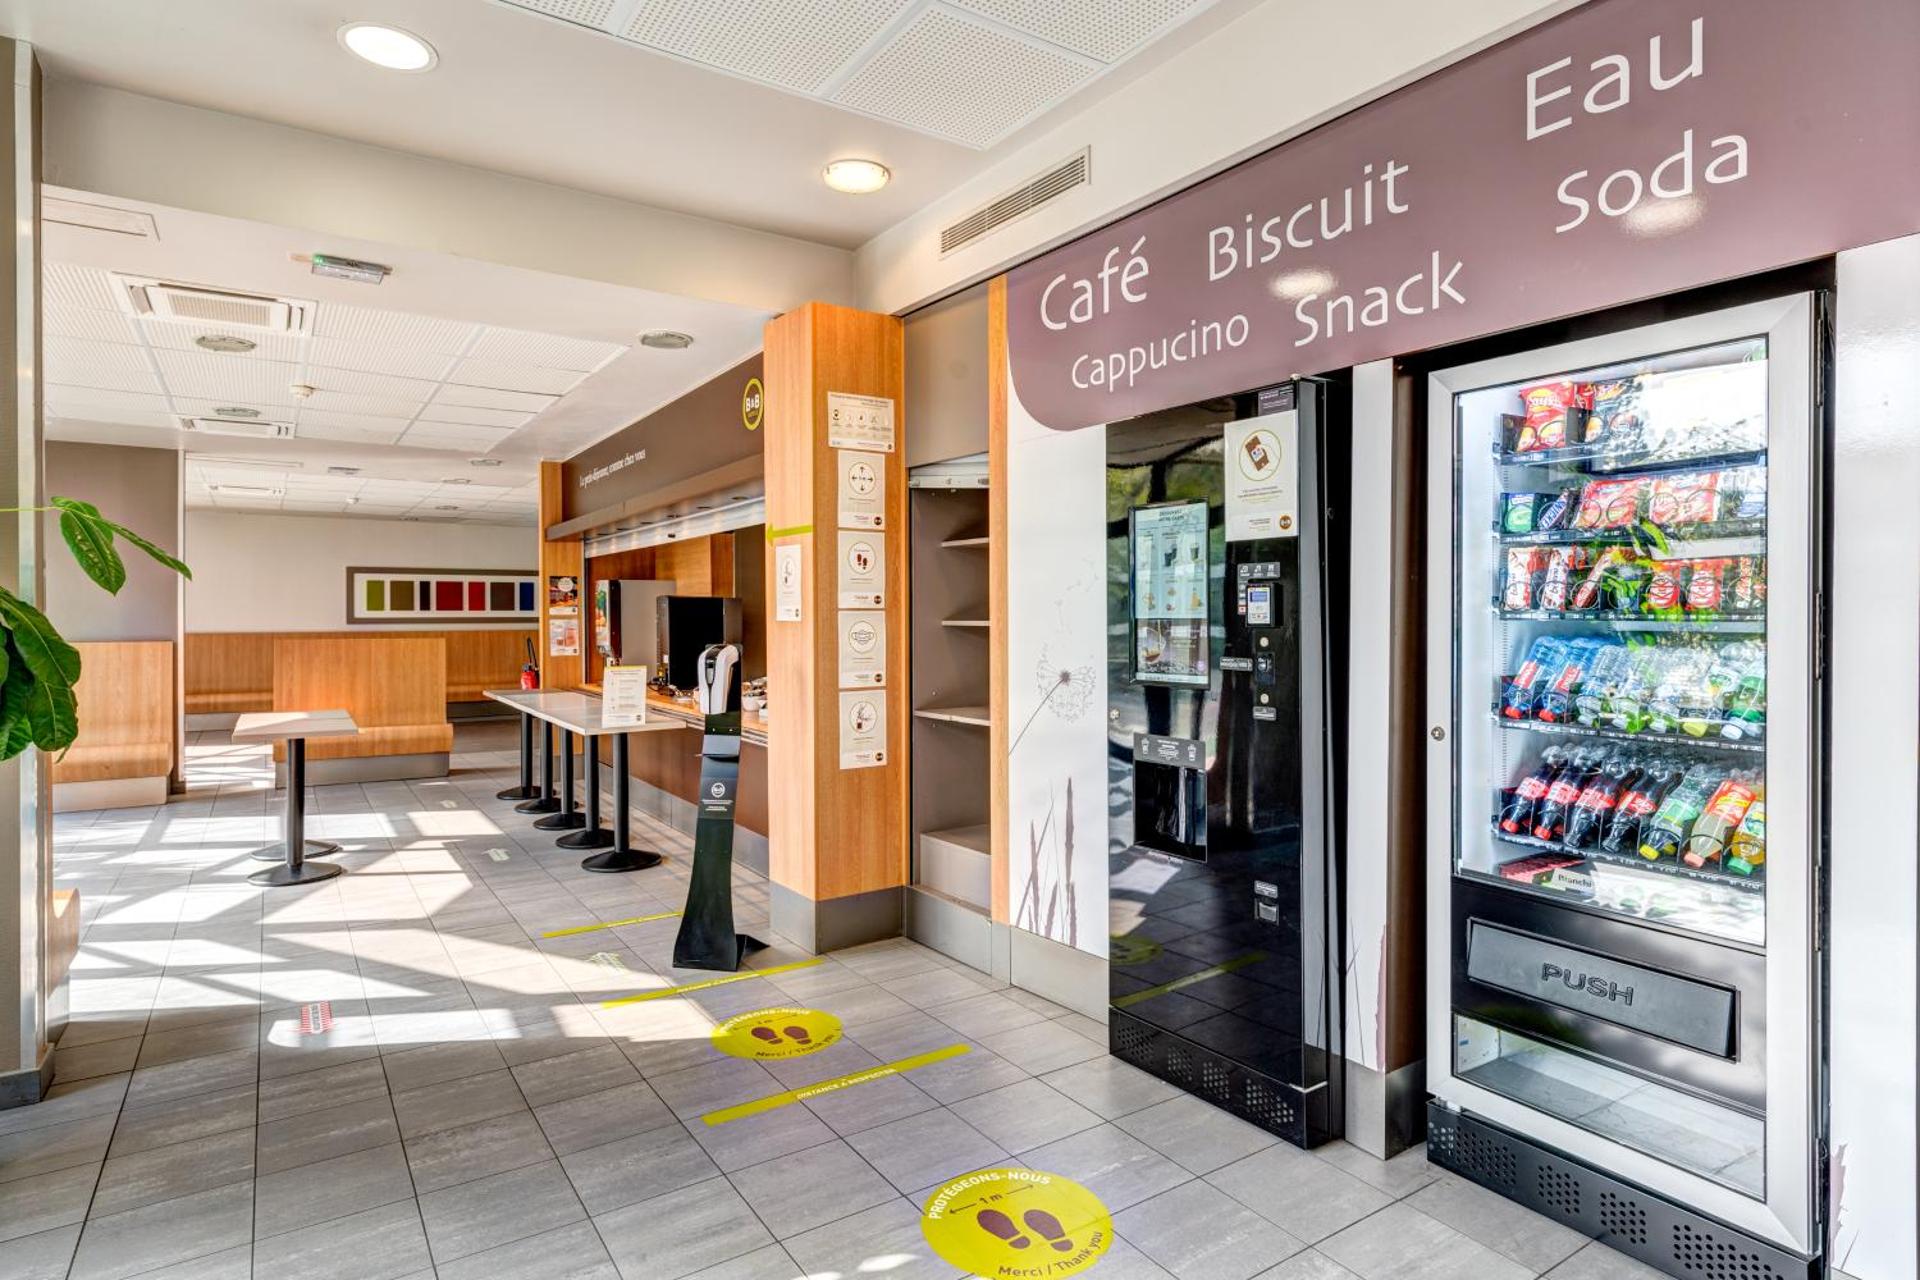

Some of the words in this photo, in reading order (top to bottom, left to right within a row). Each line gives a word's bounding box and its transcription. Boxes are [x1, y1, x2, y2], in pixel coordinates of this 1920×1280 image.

[1526, 16, 1703, 141] Eau
[1208, 159, 1409, 282] Biscuit
[1555, 128, 1748, 234] Soda
[1040, 235, 1149, 331] Café
[1294, 250, 1466, 347] Snack
[1071, 313, 1250, 392] Cappucino
[745, 393, 760, 413] B&B
[1541, 962, 1634, 1006] PUSH
[928, 1171, 1052, 1220] PROTÉGEONS-NOUS
[979, 1196, 988, 1205] 1
[991, 1192, 1002, 1202] m
[998, 1264, 1043, 1278] Merci
[1055, 1246, 1093, 1272] Thank
[1088, 1231, 1104, 1251] you
